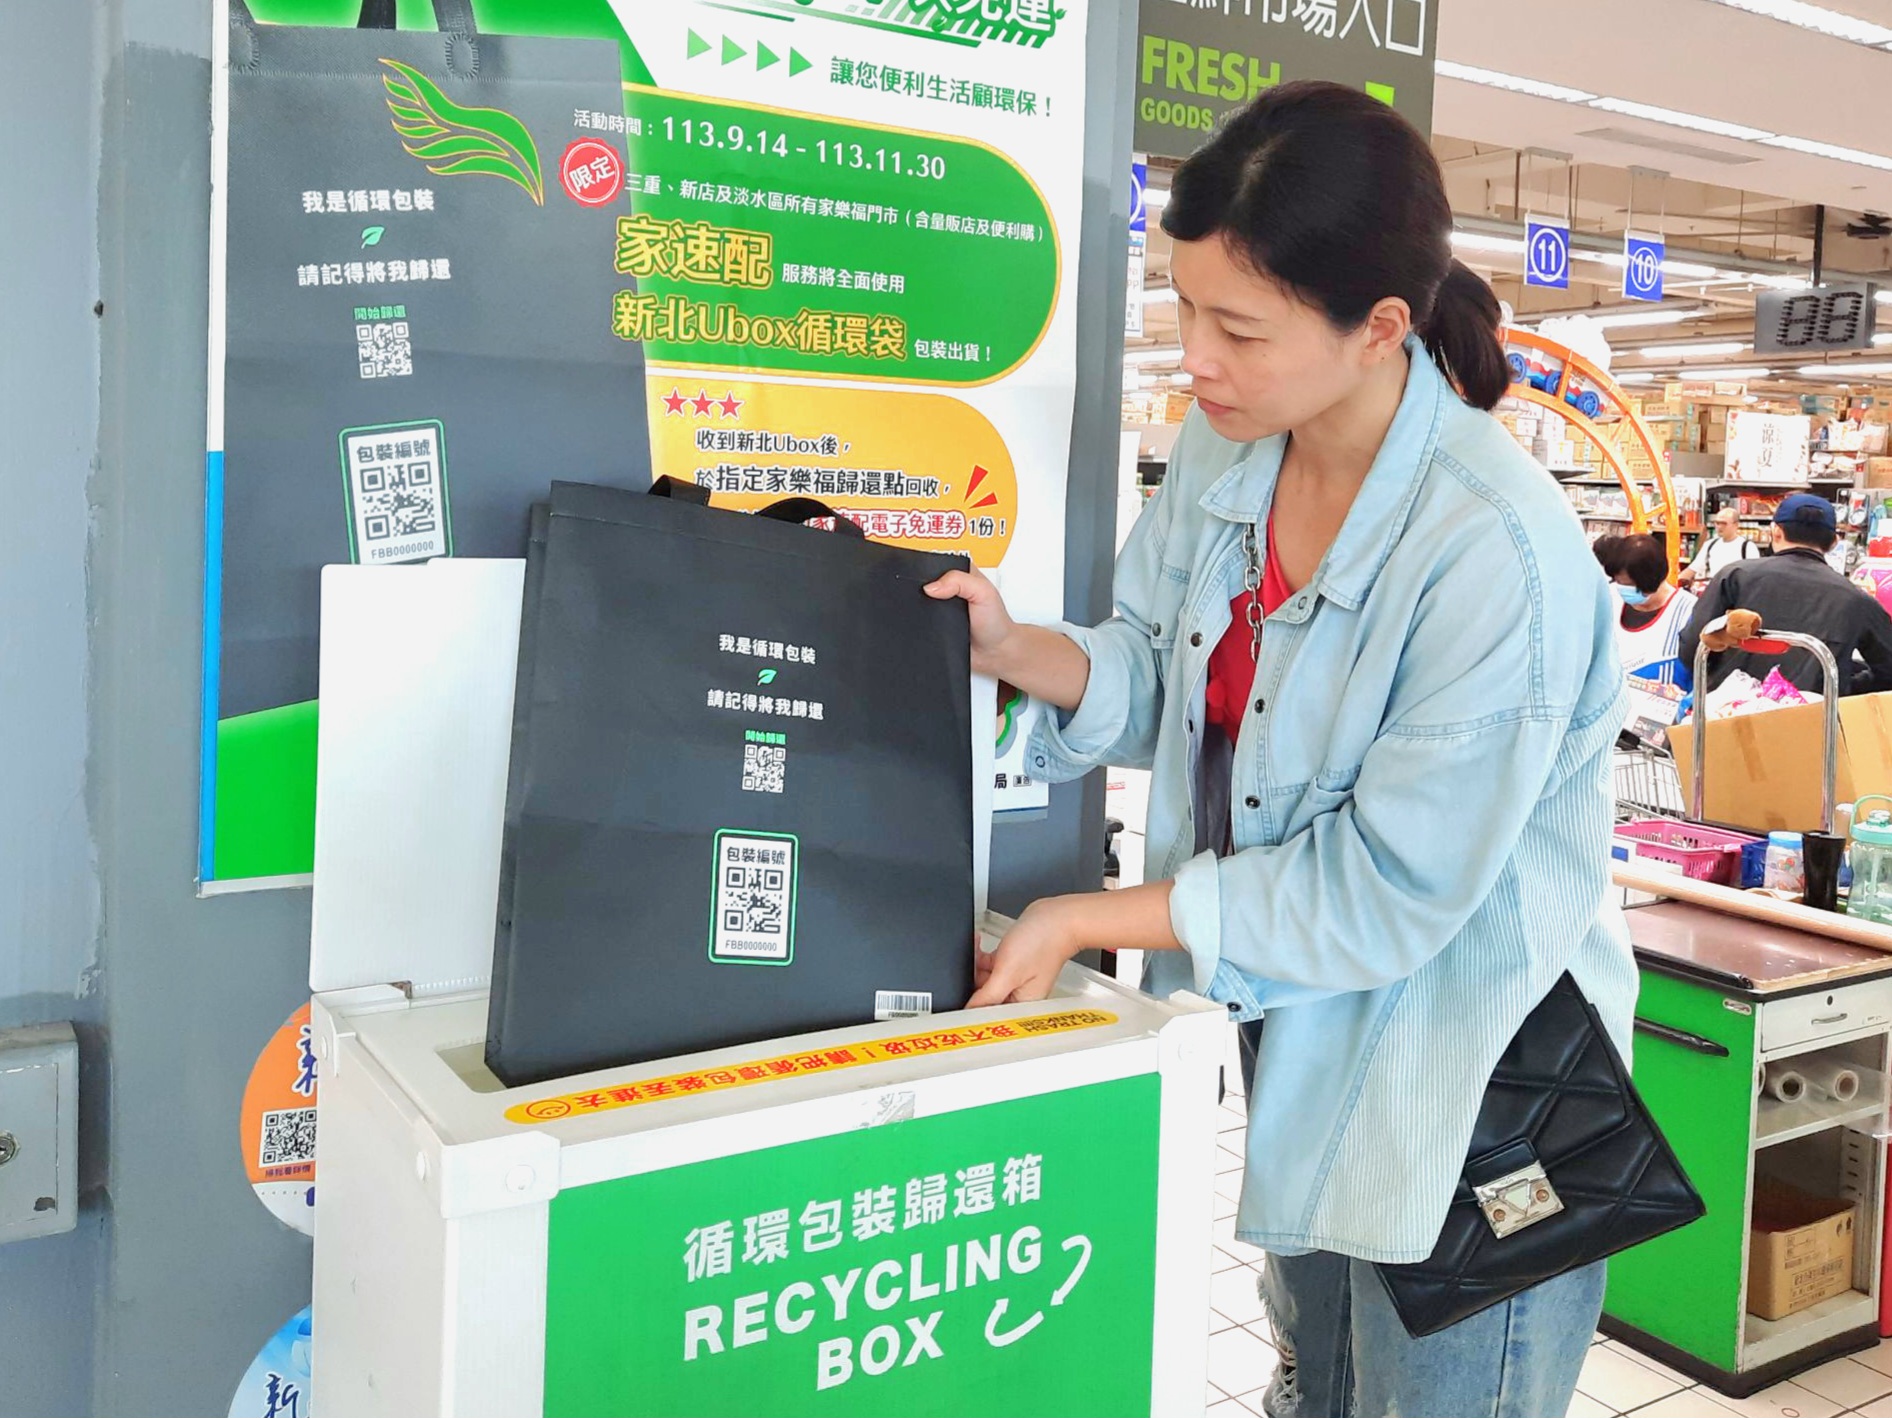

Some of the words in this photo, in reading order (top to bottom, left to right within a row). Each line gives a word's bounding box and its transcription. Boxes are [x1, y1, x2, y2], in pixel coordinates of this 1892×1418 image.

[1142, 35, 1281, 101] FRESH
[830, 56, 1052, 118] 讓您便利生活顧環保！
[1140, 98, 1213, 131] GOODS
[569, 156, 616, 193] 限定
[302, 189, 435, 214] 我是循環包裝
[615, 216, 773, 289] 家速配
[782, 262, 905, 295] 服務將全面使用
[1538, 238, 1556, 272] 11
[1635, 253, 1654, 285] 10
[297, 258, 451, 287] 請記得將我歸還
[612, 291, 907, 361] 新北Ubox循環袋
[914, 337, 991, 362] 包裝出貨！
[357, 439, 431, 463] 包裝編號
[719, 634, 816, 664] 我是循環包裝
[707, 689, 824, 720] 請記得將我歸還
[727, 847, 785, 865] 包裝編號
[682, 1153, 1043, 1282] 循環包裝歸還箱
[684, 1225, 1042, 1361] RECYCLING
[817, 1310, 944, 1391] BOX
